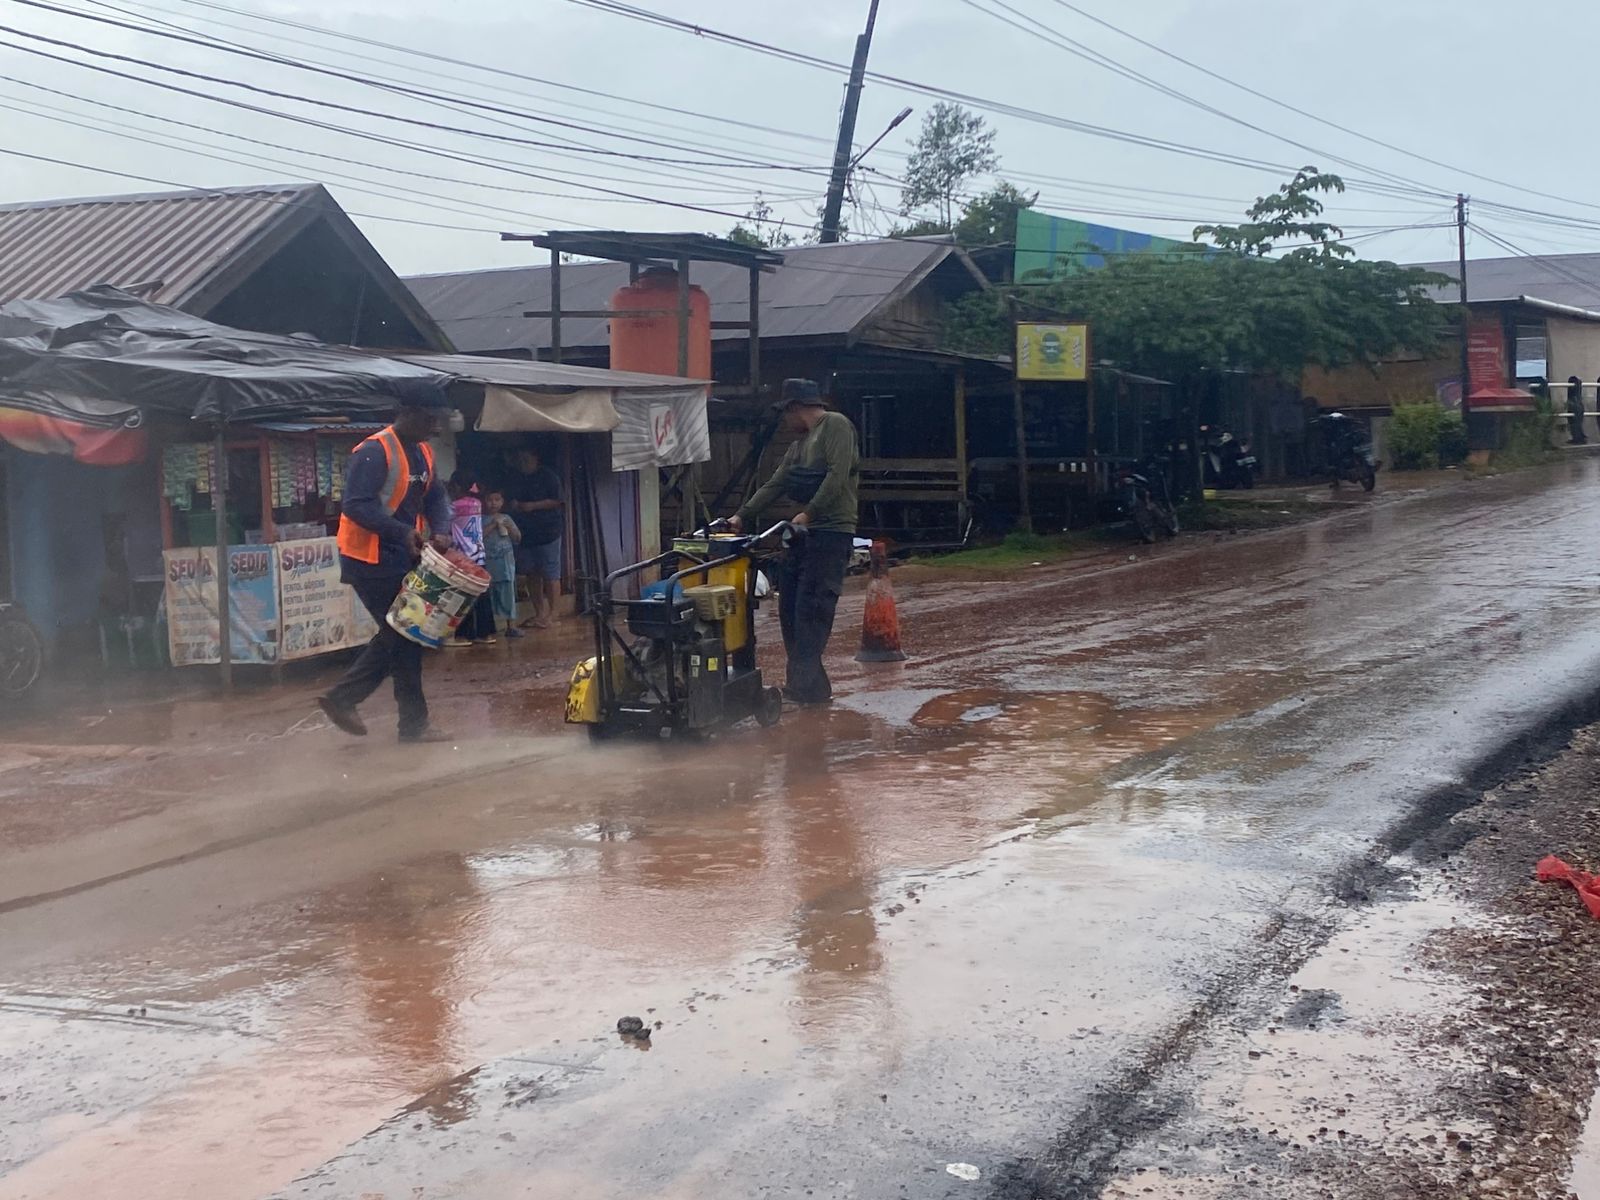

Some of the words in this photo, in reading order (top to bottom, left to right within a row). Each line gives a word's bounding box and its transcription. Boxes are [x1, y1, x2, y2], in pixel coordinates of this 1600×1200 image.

[463, 516, 479, 544] 4
[169, 558, 212, 581] SEDIA
[231, 552, 268, 575] SEDIA
[282, 543, 333, 571] SEDIA
